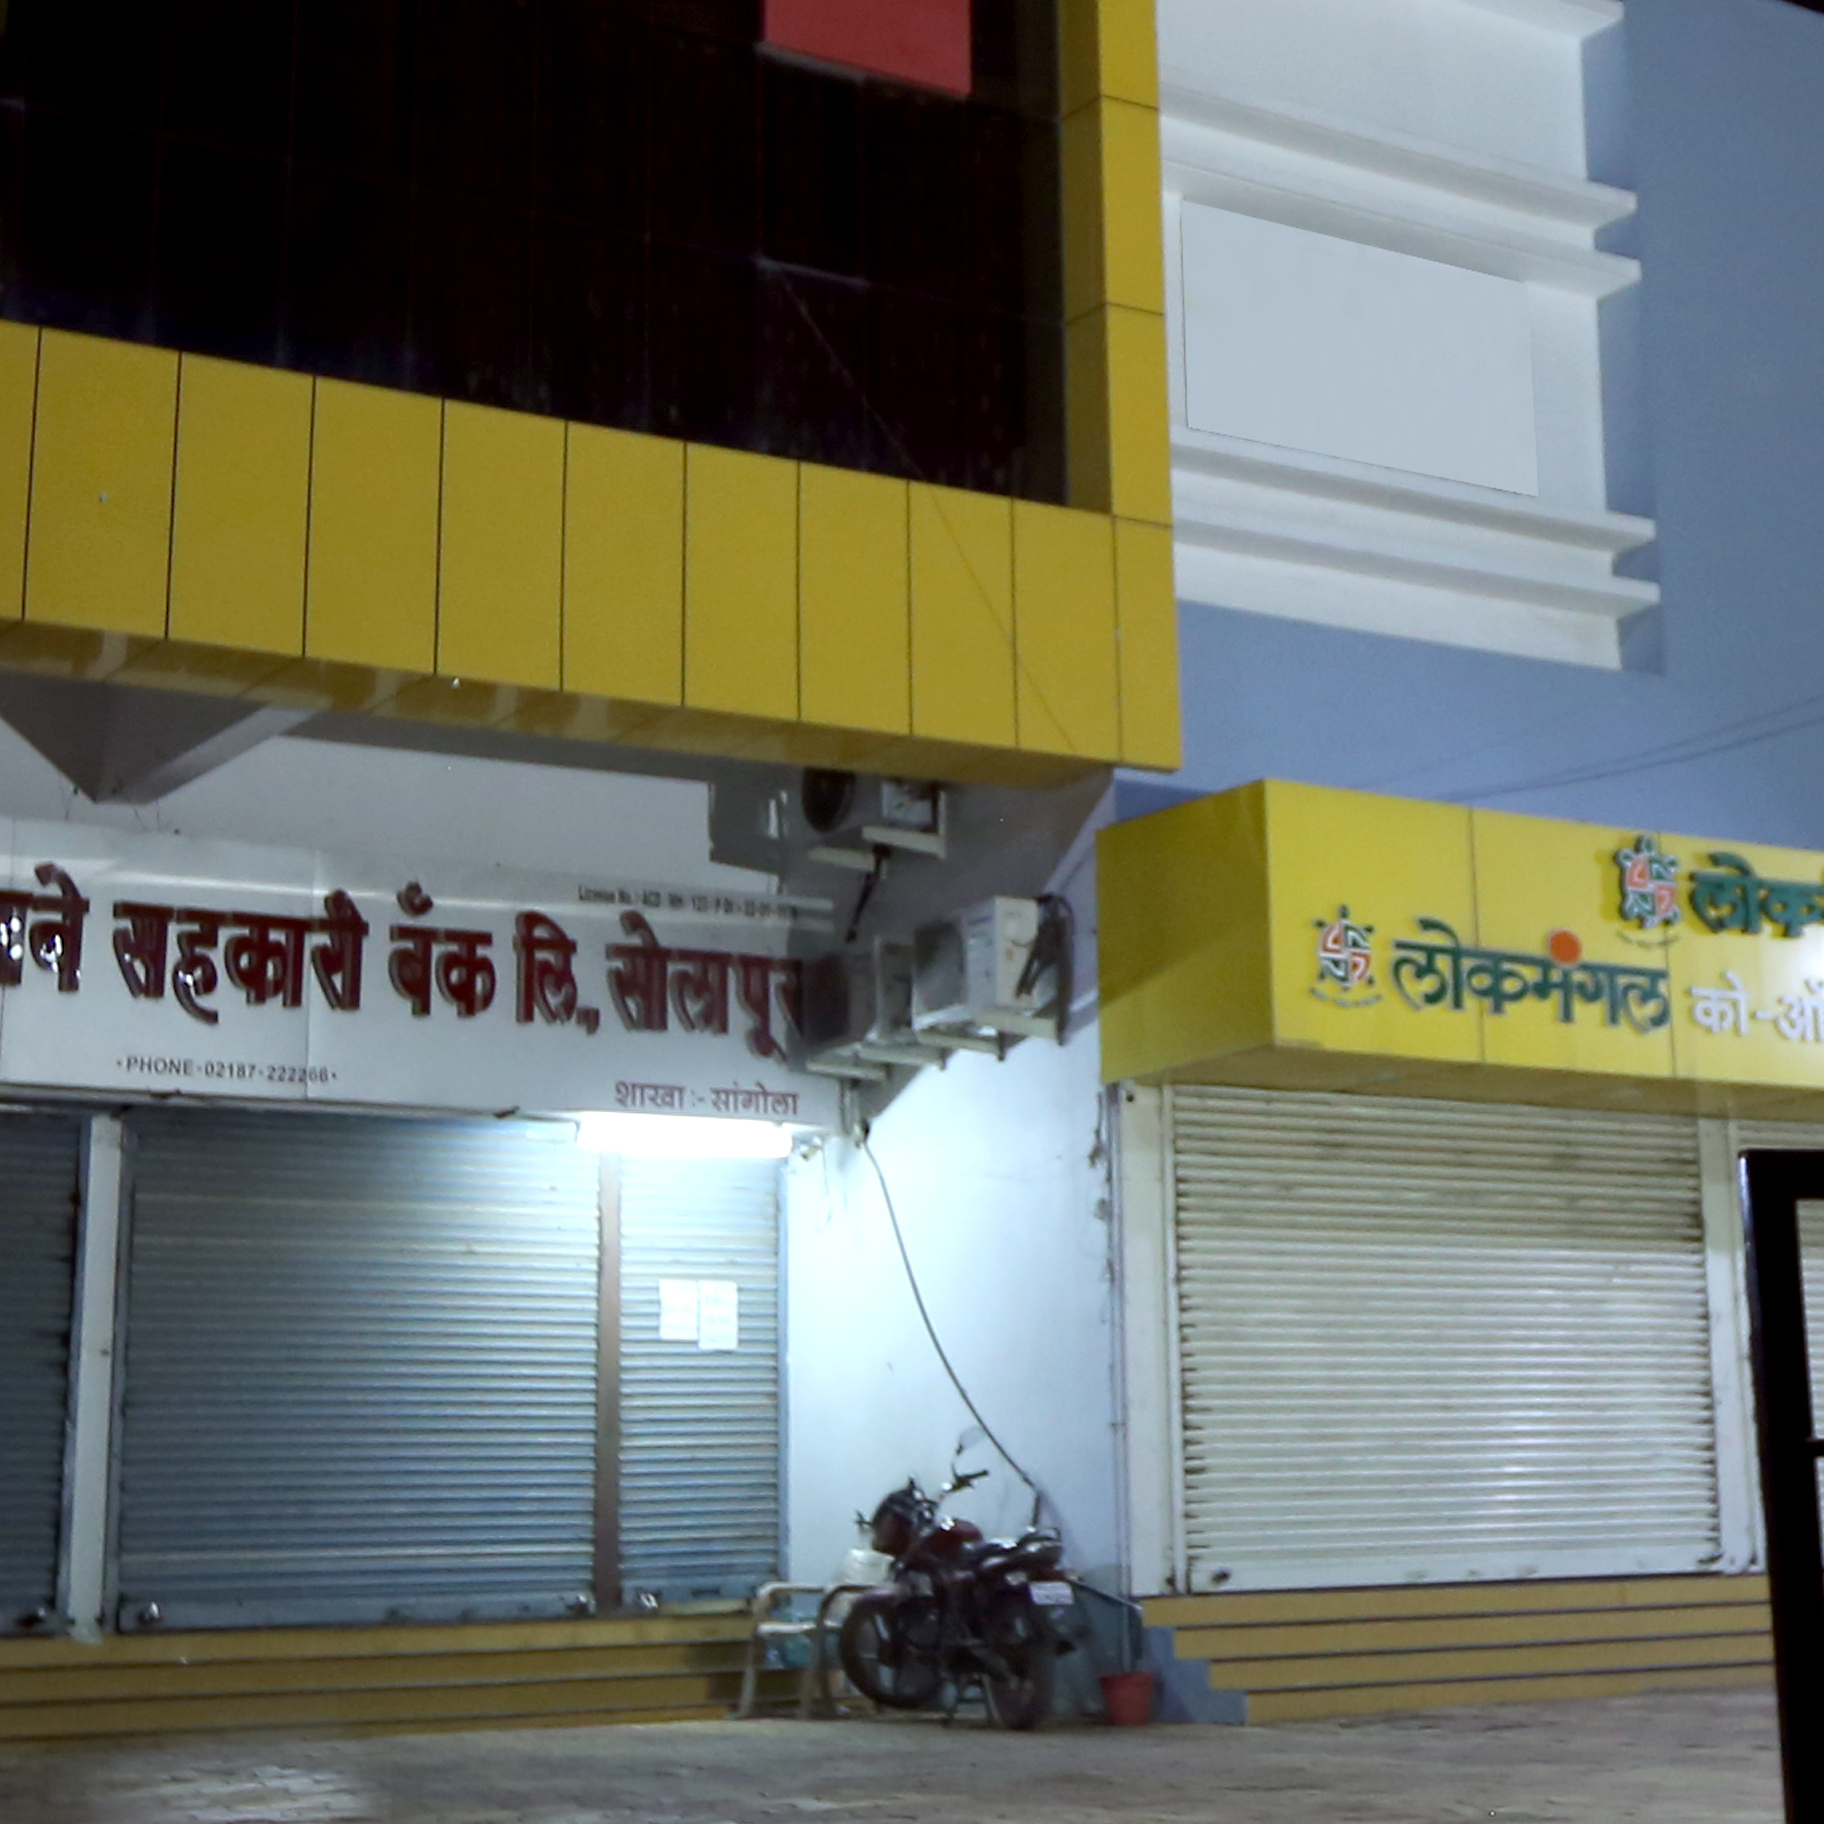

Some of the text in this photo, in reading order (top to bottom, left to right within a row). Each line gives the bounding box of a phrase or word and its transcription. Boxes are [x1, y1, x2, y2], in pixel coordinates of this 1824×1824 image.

[111, 887, 370, 1025] सहकारी
[388, 879, 495, 1018] बँक
[1392, 916, 1672, 1034] लोकमंगल
[709, 1081, 799, 1117] सांगोला
